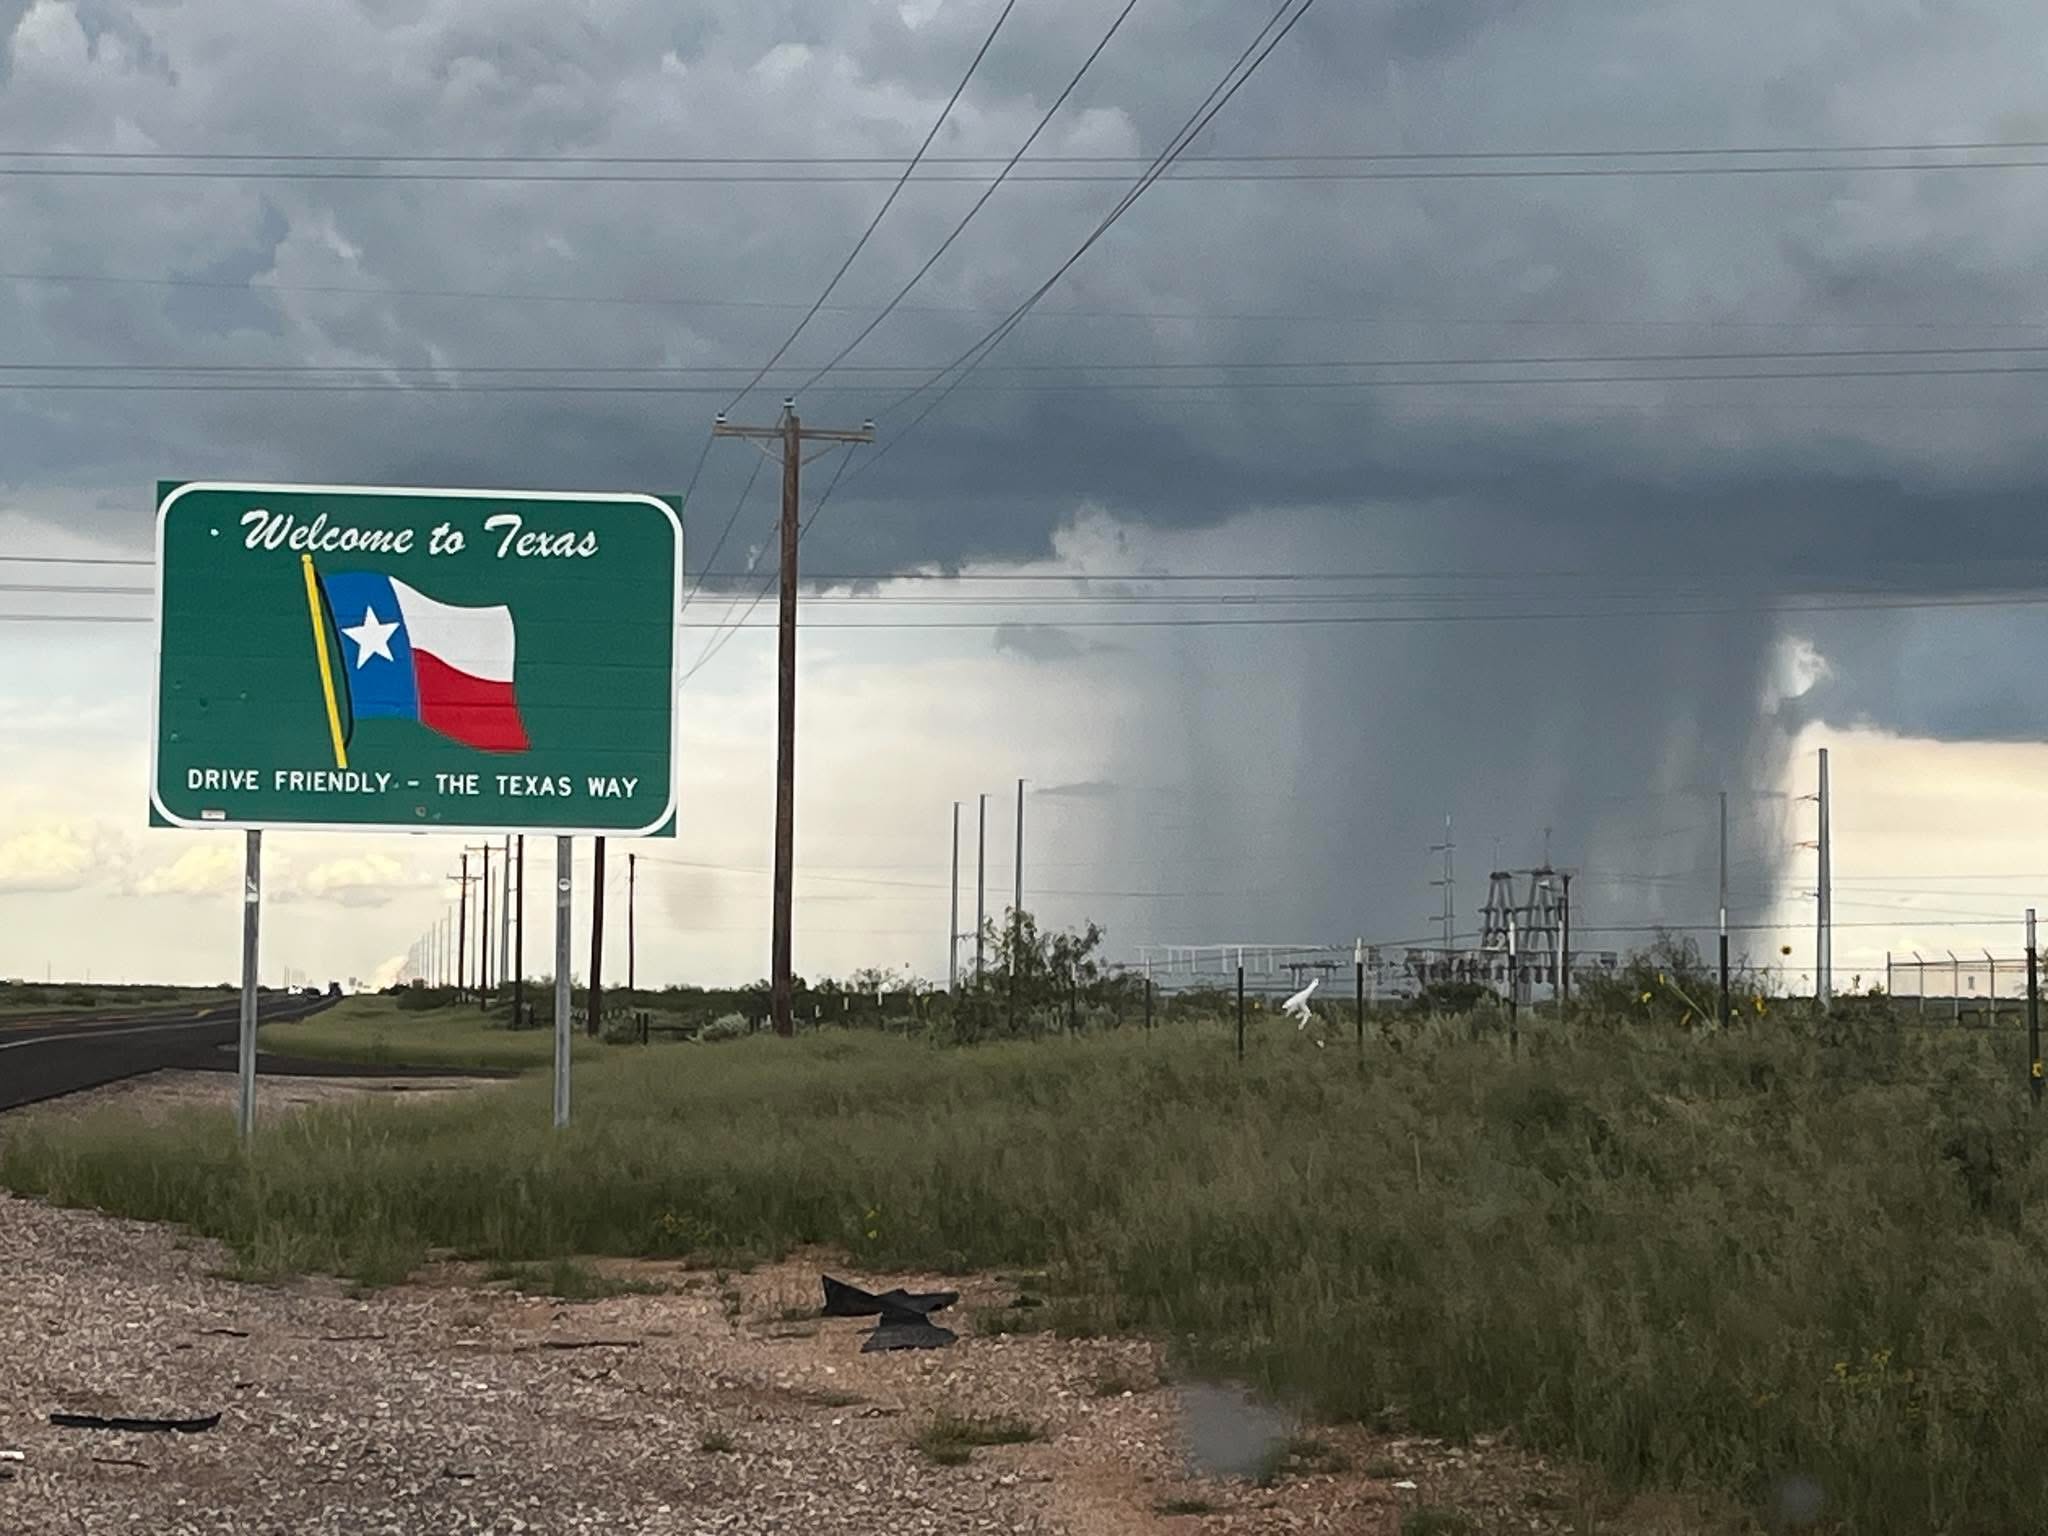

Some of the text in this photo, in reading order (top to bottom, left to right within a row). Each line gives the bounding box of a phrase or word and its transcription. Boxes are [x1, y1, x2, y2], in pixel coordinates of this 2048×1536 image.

[240, 509, 599, 558] Welcome to Texas
[188, 768, 259, 790] DRIVE
[275, 770, 391, 793] FRIENDLY
[435, 773, 479, 795] THE
[495, 775, 572, 797] TEXAS
[587, 777, 638, 798] WAY
